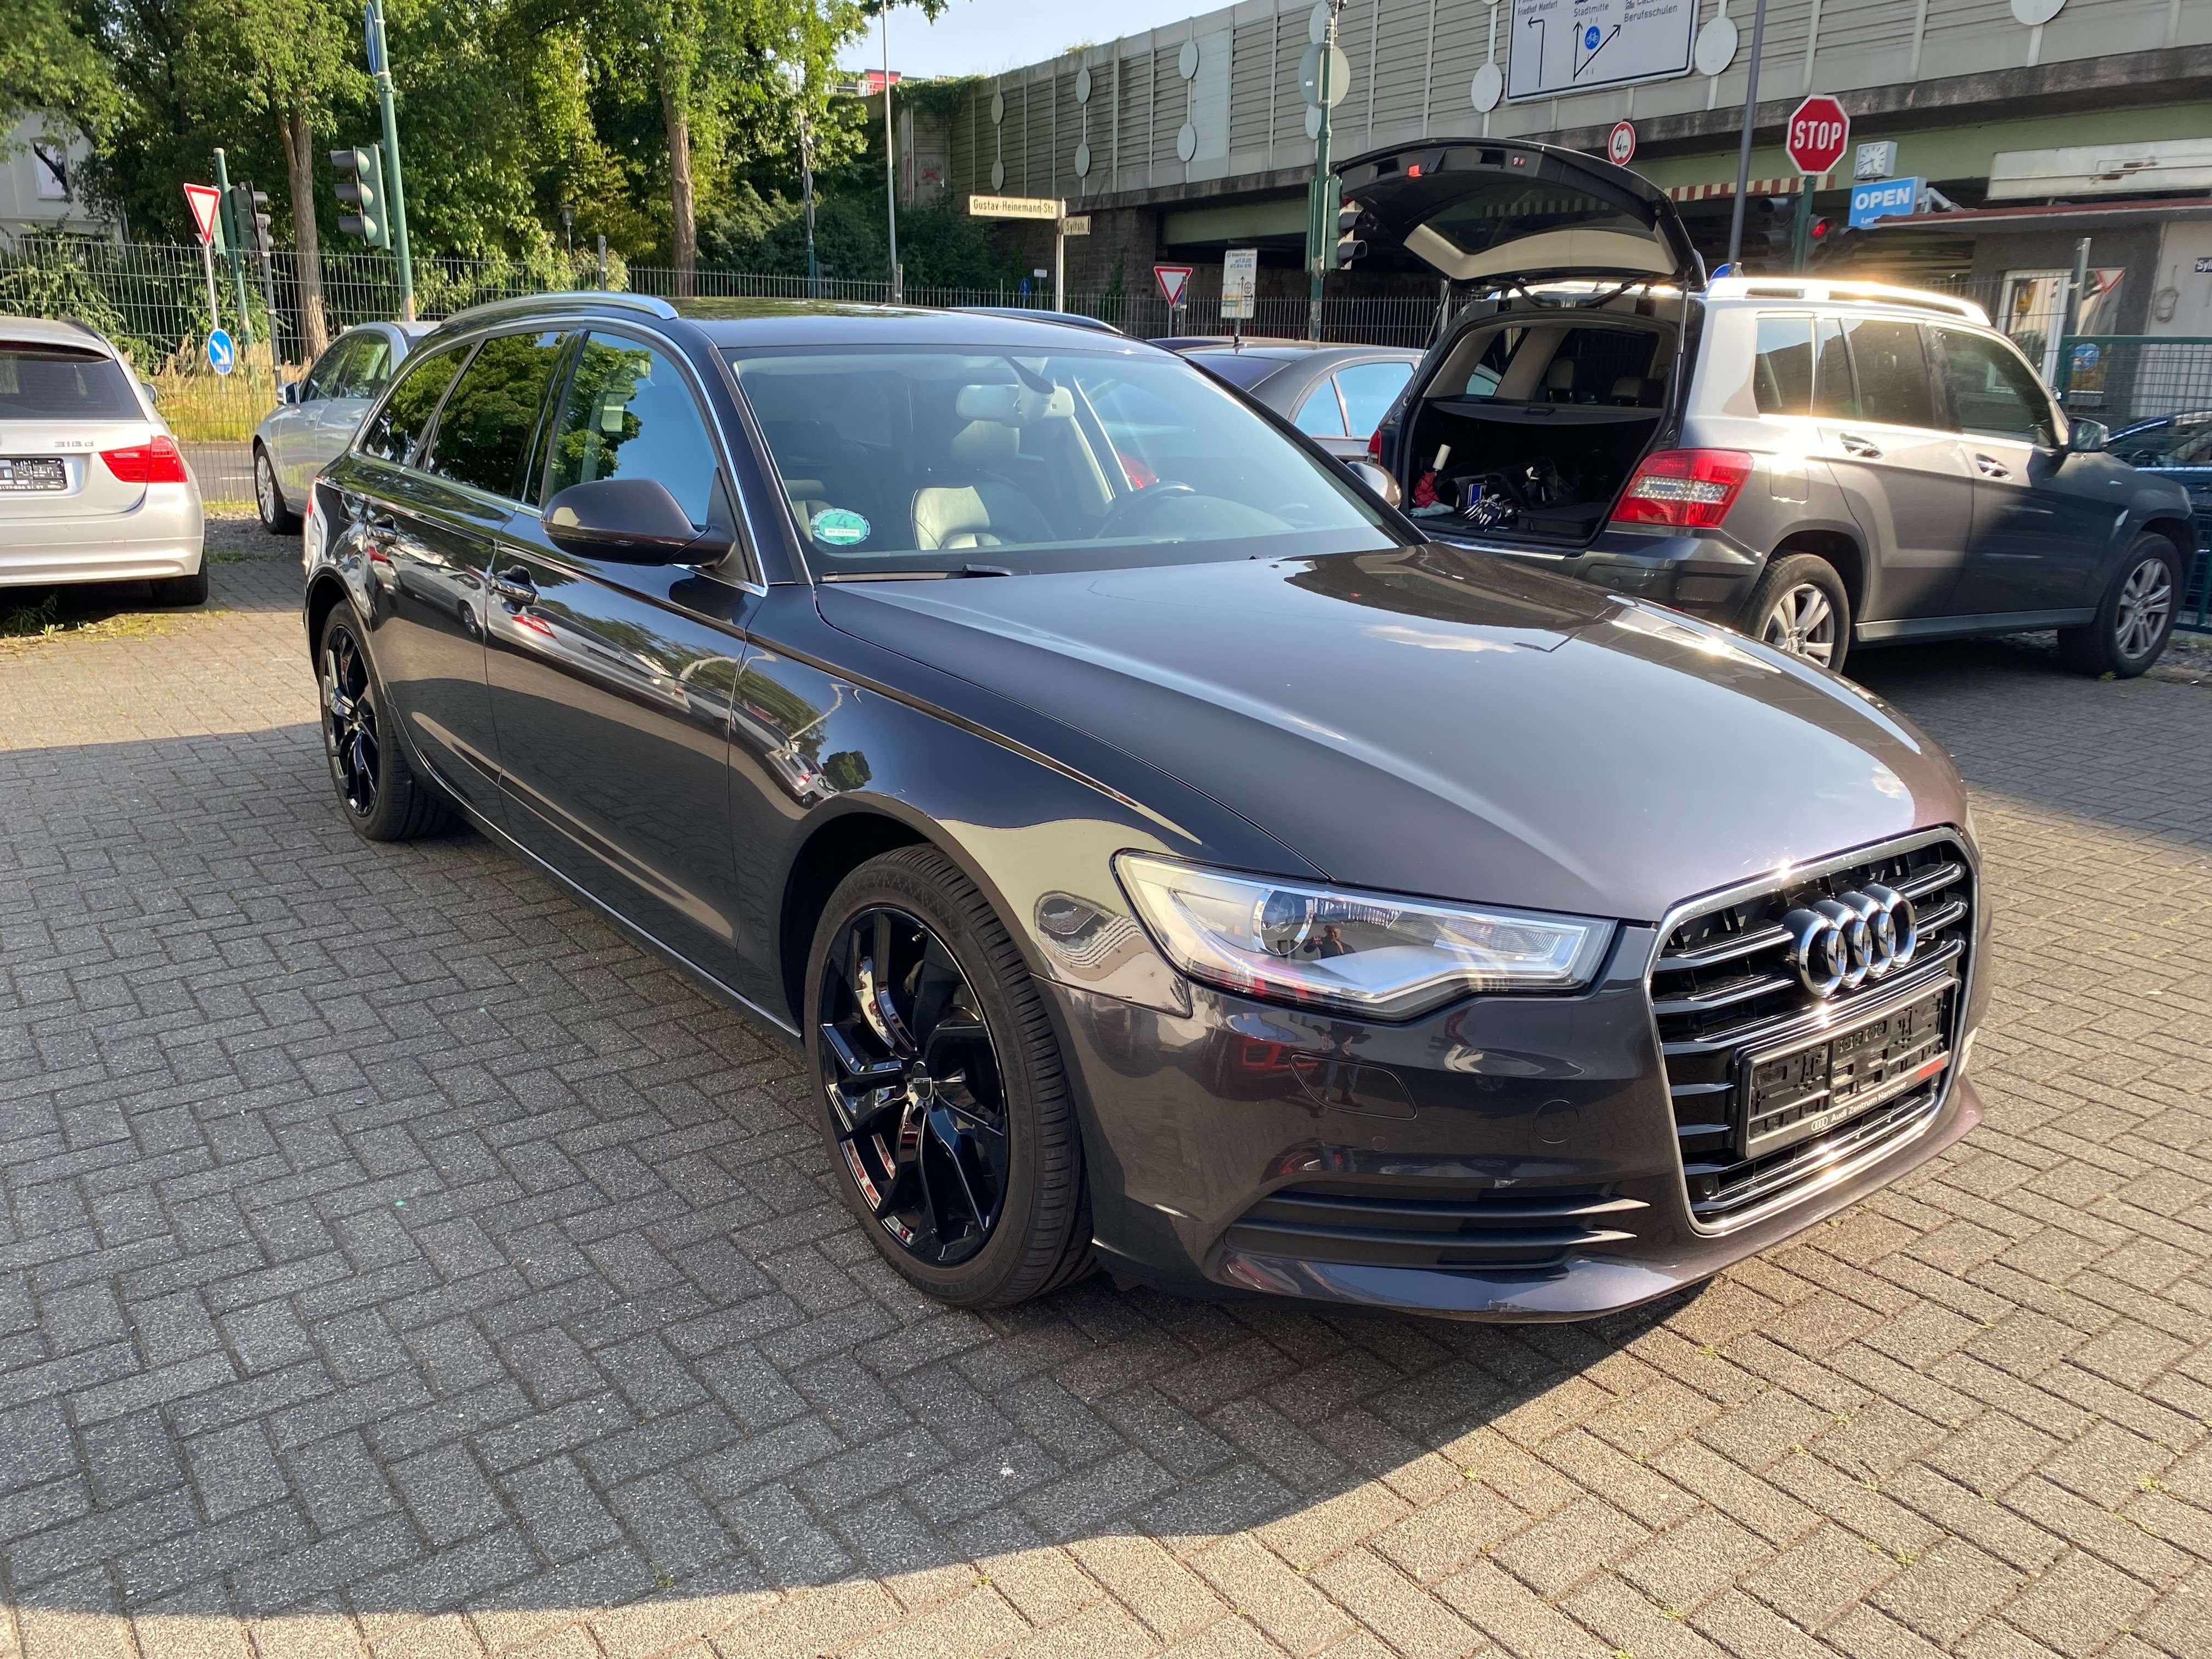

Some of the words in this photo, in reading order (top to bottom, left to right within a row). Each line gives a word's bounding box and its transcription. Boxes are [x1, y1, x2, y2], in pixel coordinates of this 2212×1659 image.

[1517, 4, 1537, 16] Friedhof
[1538, 1, 1558, 12] Manfort
[1573, 3, 1609, 17] Stadtmitte
[1624, 4, 1677, 22] Berufsschulen
[1794, 120, 1842, 150] STOP
[1855, 187, 1910, 210] OPEN
[1066, 221, 1086, 232] Syltstr.
[836, 515, 848, 527] 4
[1831, 1108, 1847, 1122] Audi
[1848, 1097, 1878, 1115] Zentrum
[1878, 1081, 1908, 1101] Hannover
